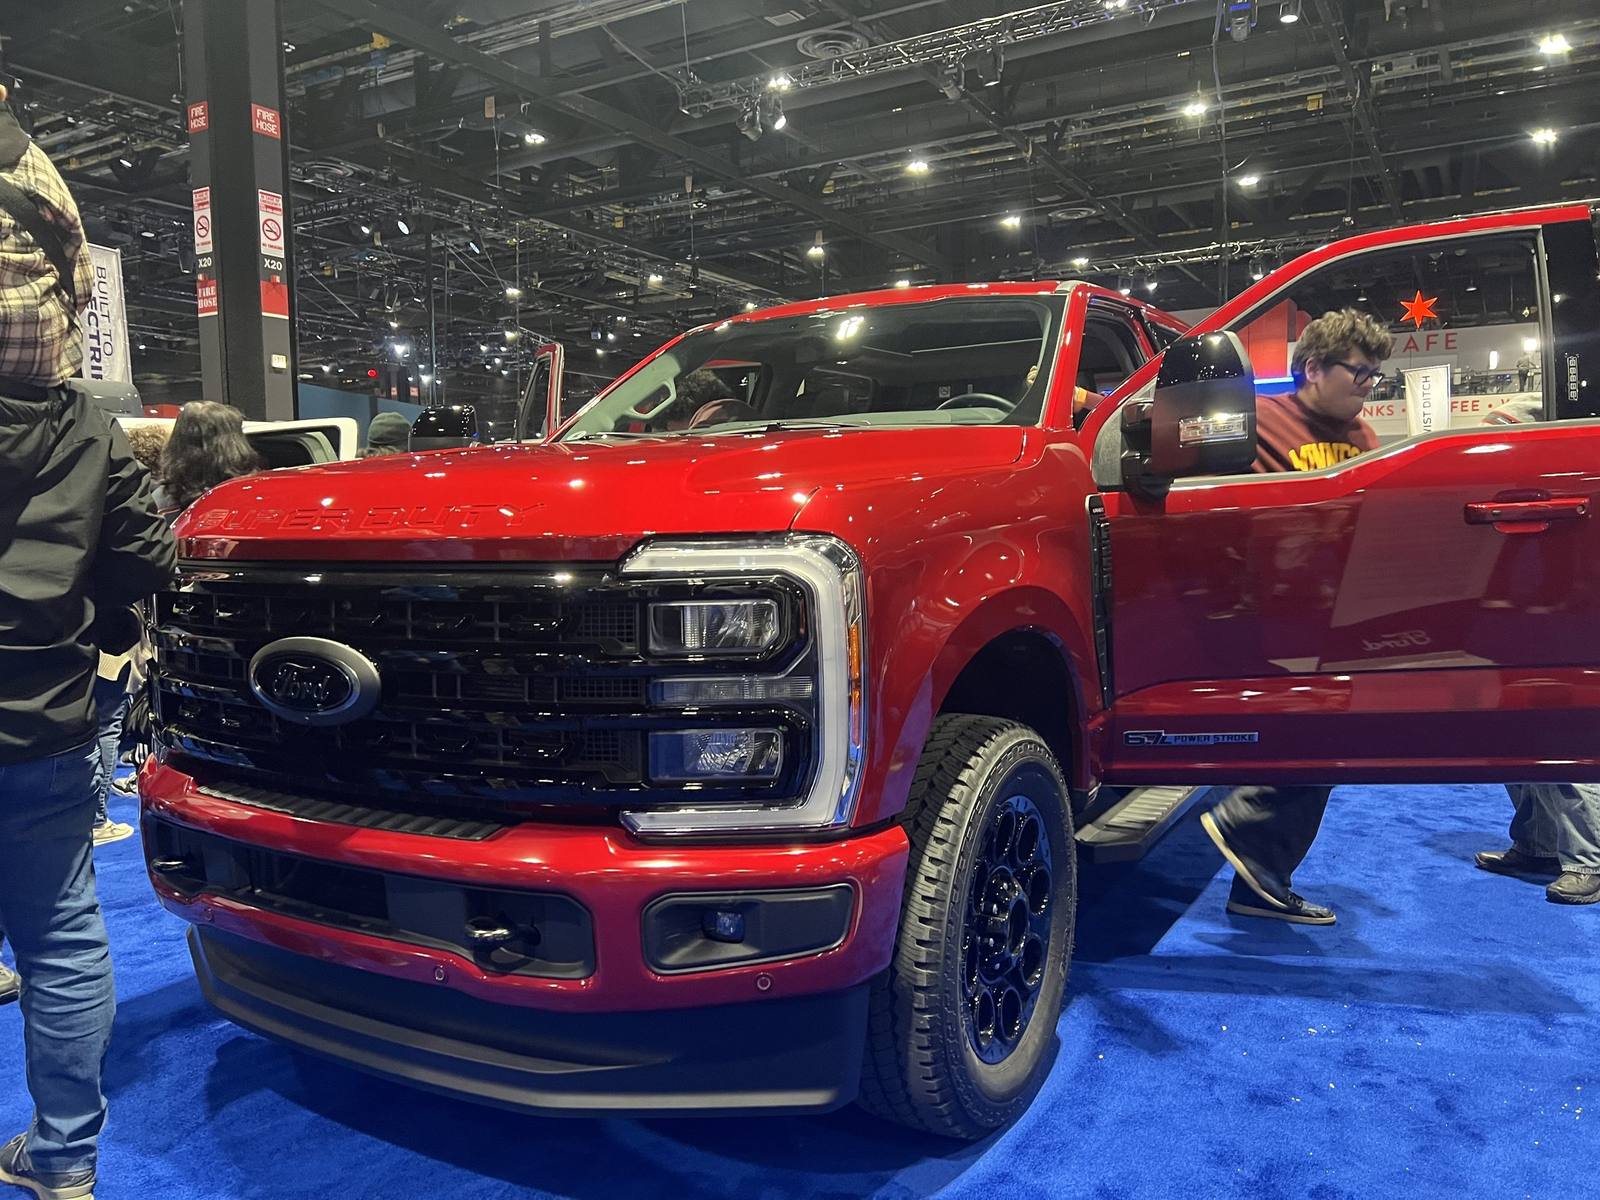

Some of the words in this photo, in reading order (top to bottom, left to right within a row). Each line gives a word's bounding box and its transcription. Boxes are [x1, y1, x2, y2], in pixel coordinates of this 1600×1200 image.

[190, 105, 205, 117] FIRE
[257, 108, 276, 123] FIRE
[190, 115, 206, 128] HOSE
[256, 119, 278, 135] HOSE
[198, 256, 212, 269] X20
[263, 258, 283, 271] X20
[96, 266, 111, 323] BUILT
[197, 286, 216, 298] FIRE
[198, 296, 217, 309] HOSE
[103, 331, 114, 357] TO
[1391, 332, 1459, 353] AFE
[1422, 375, 1431, 408] DITCH
[1362, 403, 1395, 417] NKS
[1450, 399, 1480, 413] FEE
[194, 507, 353, 531] SUPER
[359, 502, 545, 529] DUTY
[272, 661, 331, 703] Ford
[1174, 734, 1212, 744] POWER
[1213, 733, 1256, 743] STROKE
